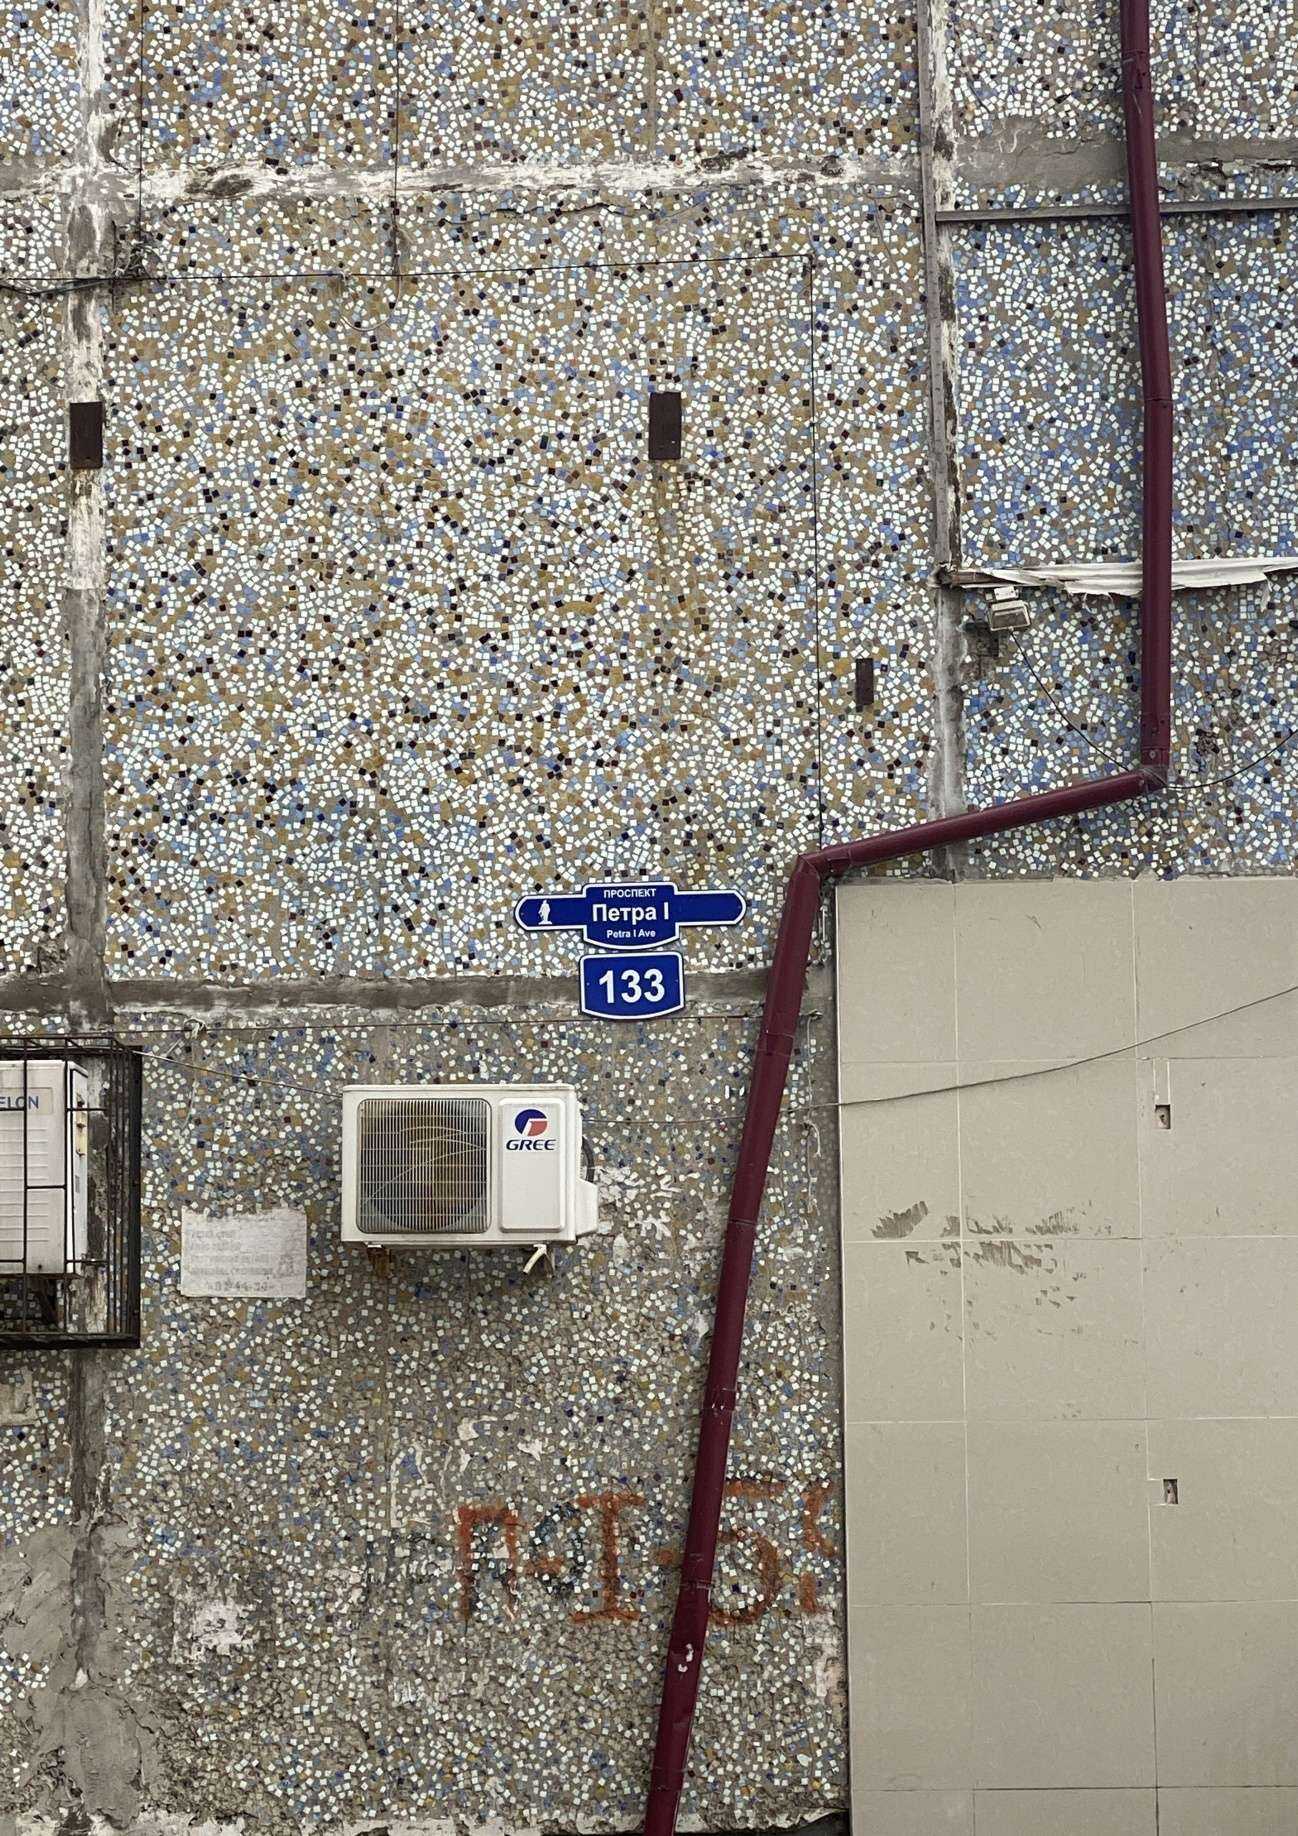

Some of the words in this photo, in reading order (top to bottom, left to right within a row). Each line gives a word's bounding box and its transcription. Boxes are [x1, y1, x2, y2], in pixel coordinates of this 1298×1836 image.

[603, 888, 657, 898] ПРОСПЕКТ
[592, 903, 657, 925] Петра
[606, 929, 631, 938] Petra
[638, 929, 656, 938] Ave
[599, 968, 665, 1004] 133
[506, 1139, 556, 1151] GREE
